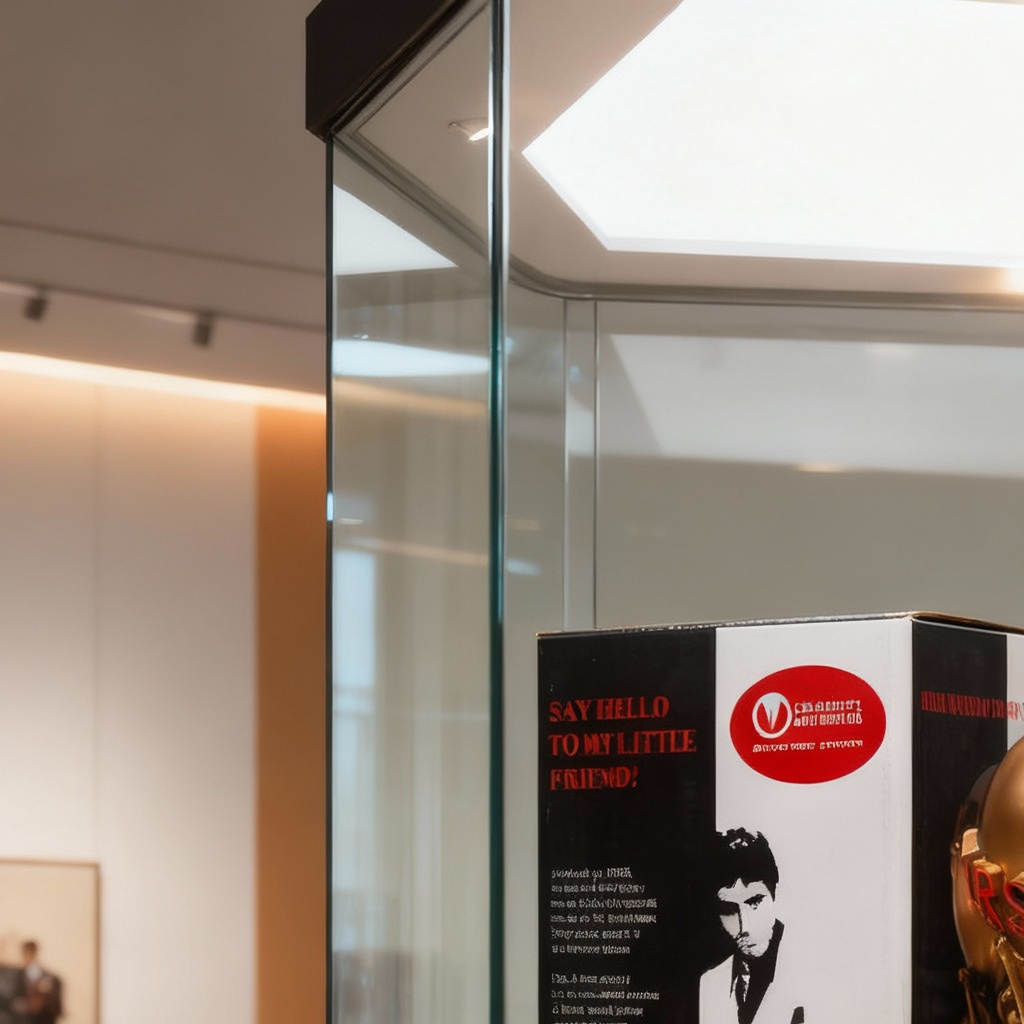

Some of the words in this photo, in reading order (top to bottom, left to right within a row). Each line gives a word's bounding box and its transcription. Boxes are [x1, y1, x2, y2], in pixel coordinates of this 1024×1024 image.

[549, 700, 591, 723] SAY
[597, 695, 670, 720] HELLO
[548, 733, 579, 756] TO
[617, 729, 697, 755] LITTLE
[550, 765, 639, 791] FRIEND!
